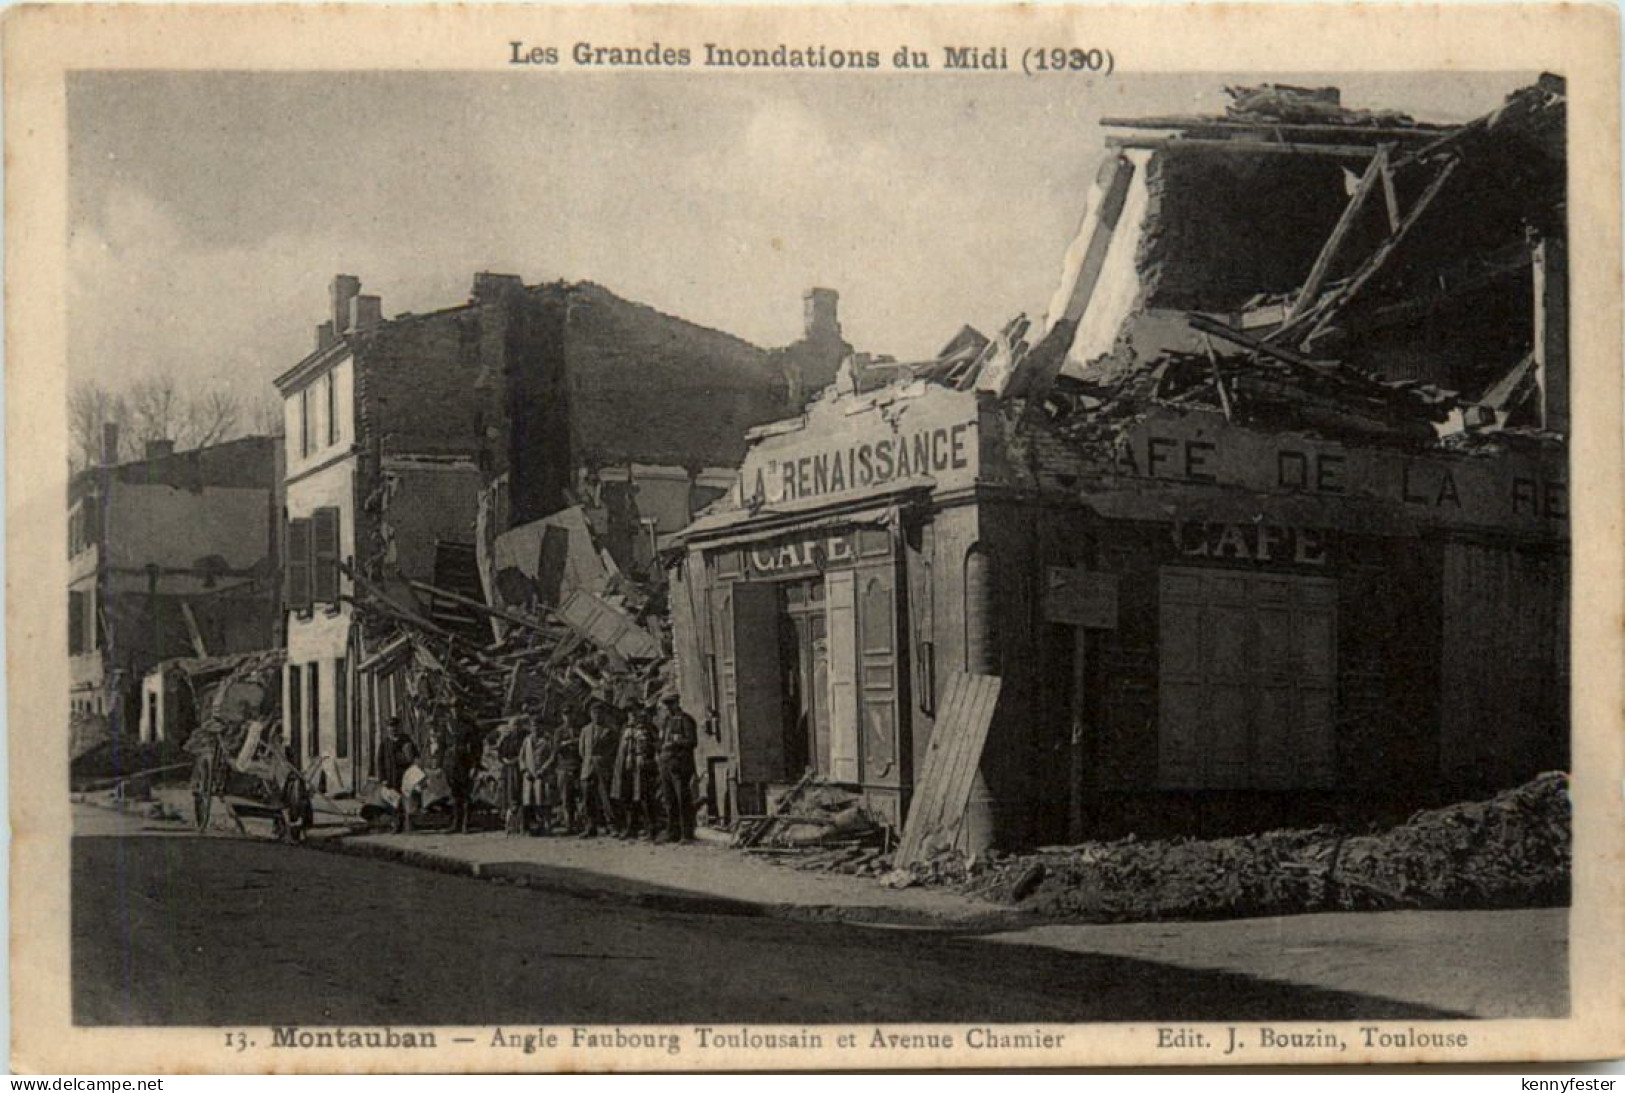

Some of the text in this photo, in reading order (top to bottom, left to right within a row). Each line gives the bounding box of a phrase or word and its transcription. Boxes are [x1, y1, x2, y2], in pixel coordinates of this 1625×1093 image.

[782, 423, 968, 503] RENAISSANCE
[1113, 428, 1218, 482] AFÉ
[1277, 450, 1347, 493] DE
[1403, 466, 1462, 510] LA
